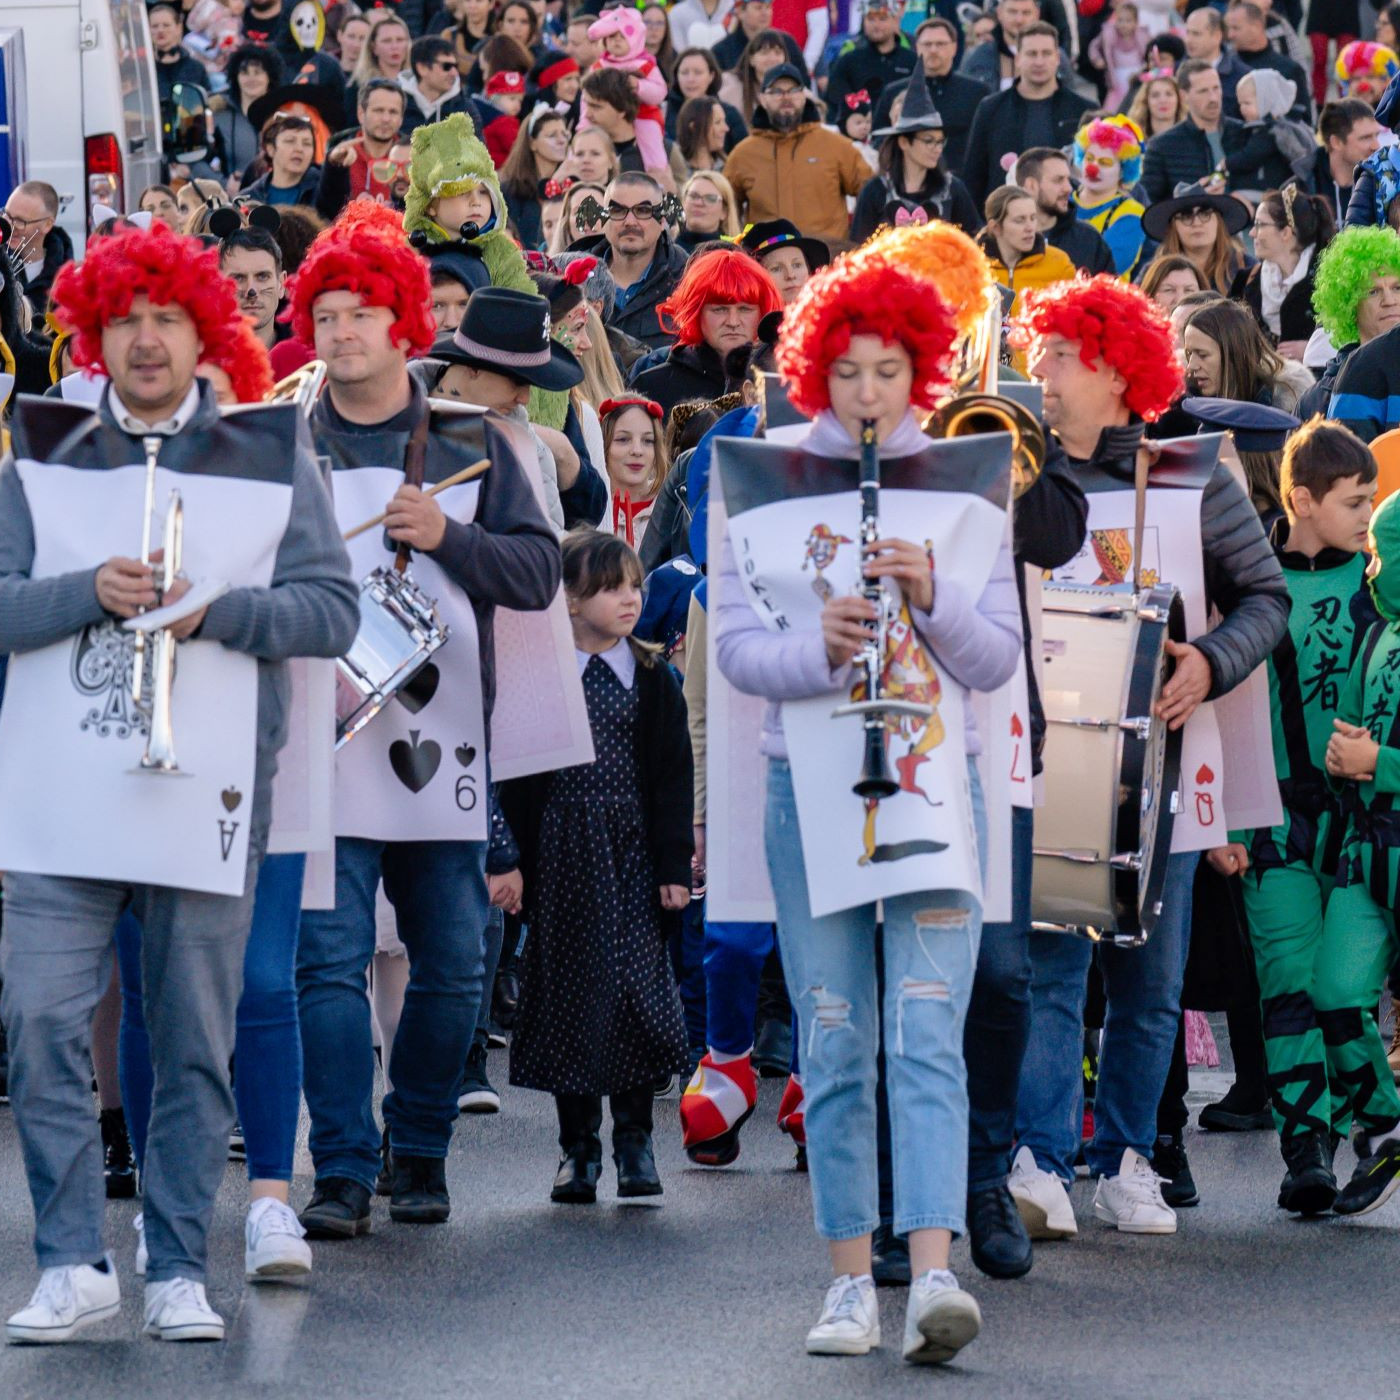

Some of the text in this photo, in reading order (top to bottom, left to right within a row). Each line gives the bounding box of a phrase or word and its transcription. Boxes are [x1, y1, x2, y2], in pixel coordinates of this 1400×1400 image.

[1303, 596, 1353, 713] 忍者
[1194, 791, 1215, 827] Q
[217, 818, 241, 862] A
